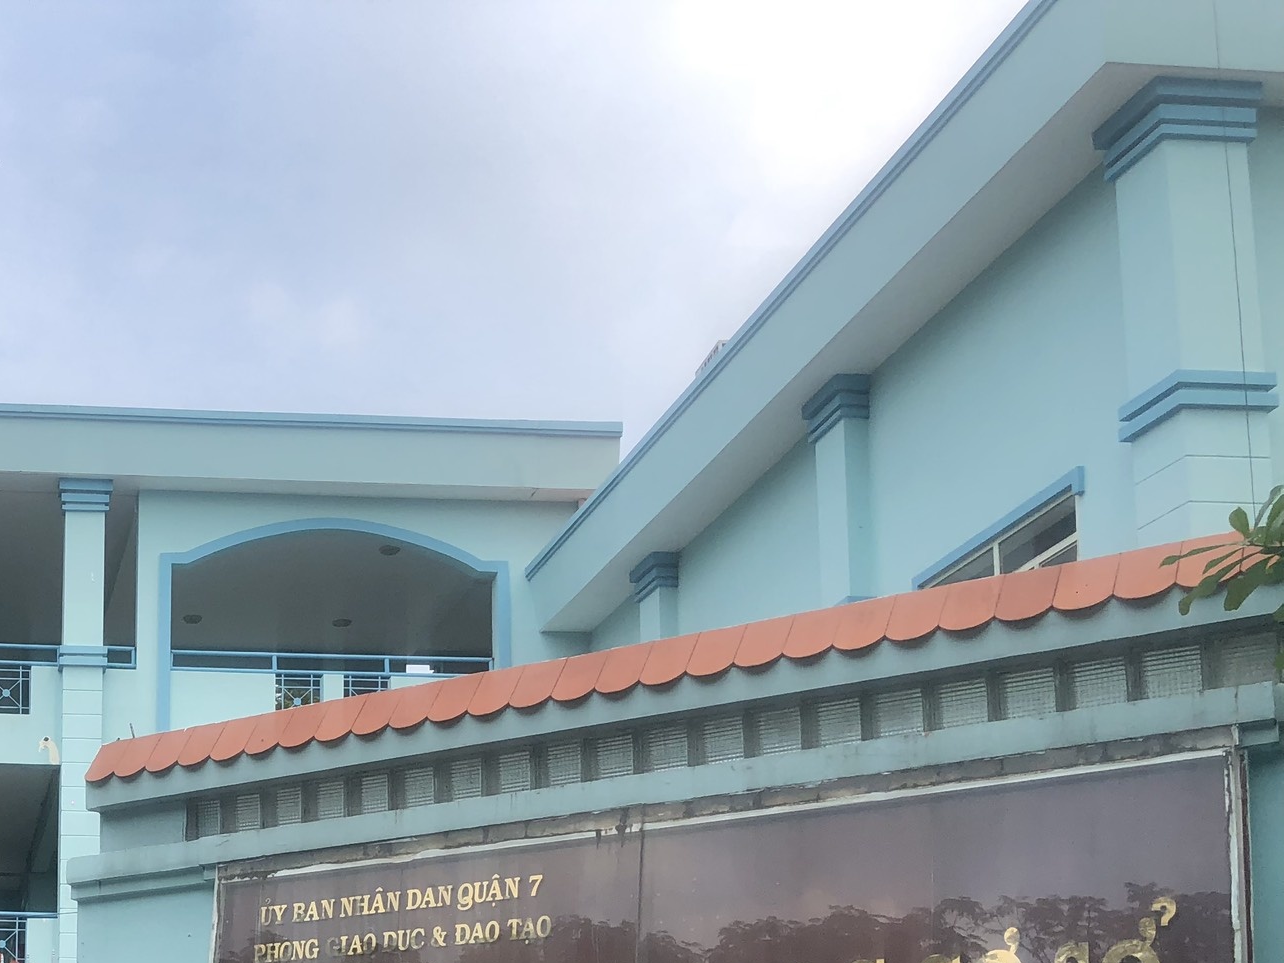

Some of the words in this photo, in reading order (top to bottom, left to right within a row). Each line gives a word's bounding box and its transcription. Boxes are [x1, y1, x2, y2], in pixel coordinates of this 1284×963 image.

[292, 898, 336, 923] BAN
[339, 886, 402, 918] NHÂN
[457, 873, 521, 911] QUẬN
[528, 874, 544, 897] 7
[430, 926, 448, 947] &
[506, 915, 552, 945] TẠO
